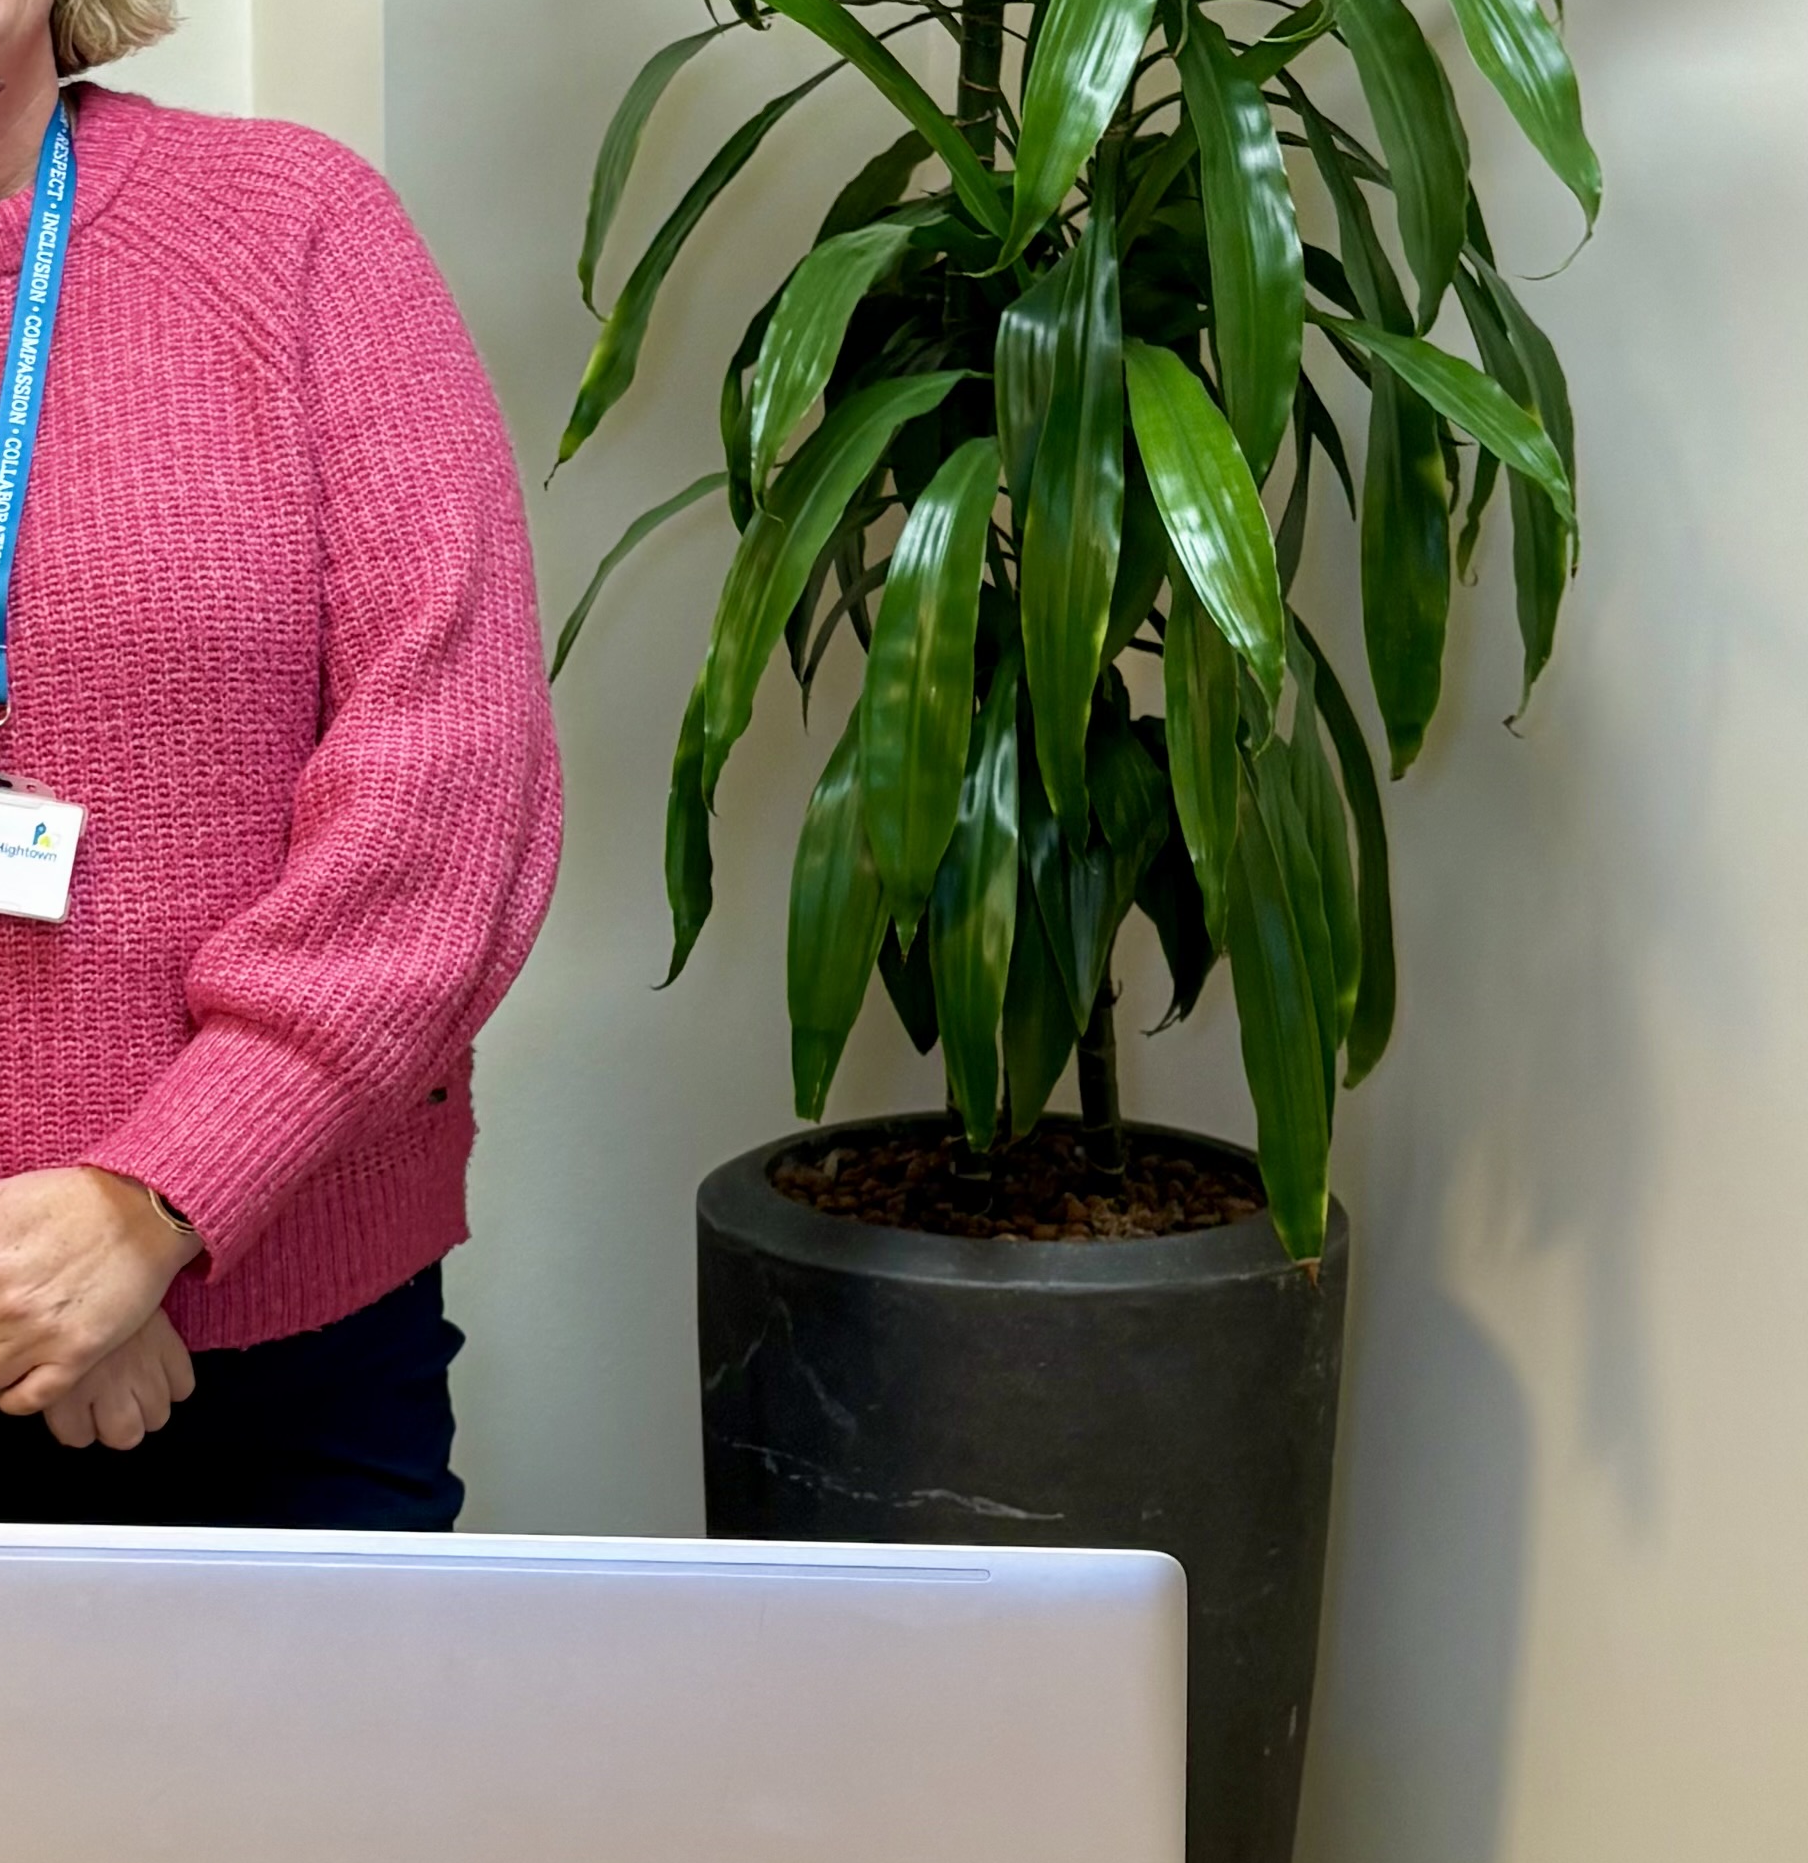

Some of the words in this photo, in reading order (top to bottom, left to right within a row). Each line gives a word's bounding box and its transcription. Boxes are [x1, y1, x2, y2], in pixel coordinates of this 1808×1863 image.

[48, 131, 70, 202] RESPECT
[29, 211, 61, 304] INCLUSION
[8, 315, 43, 425] COMPASSION
